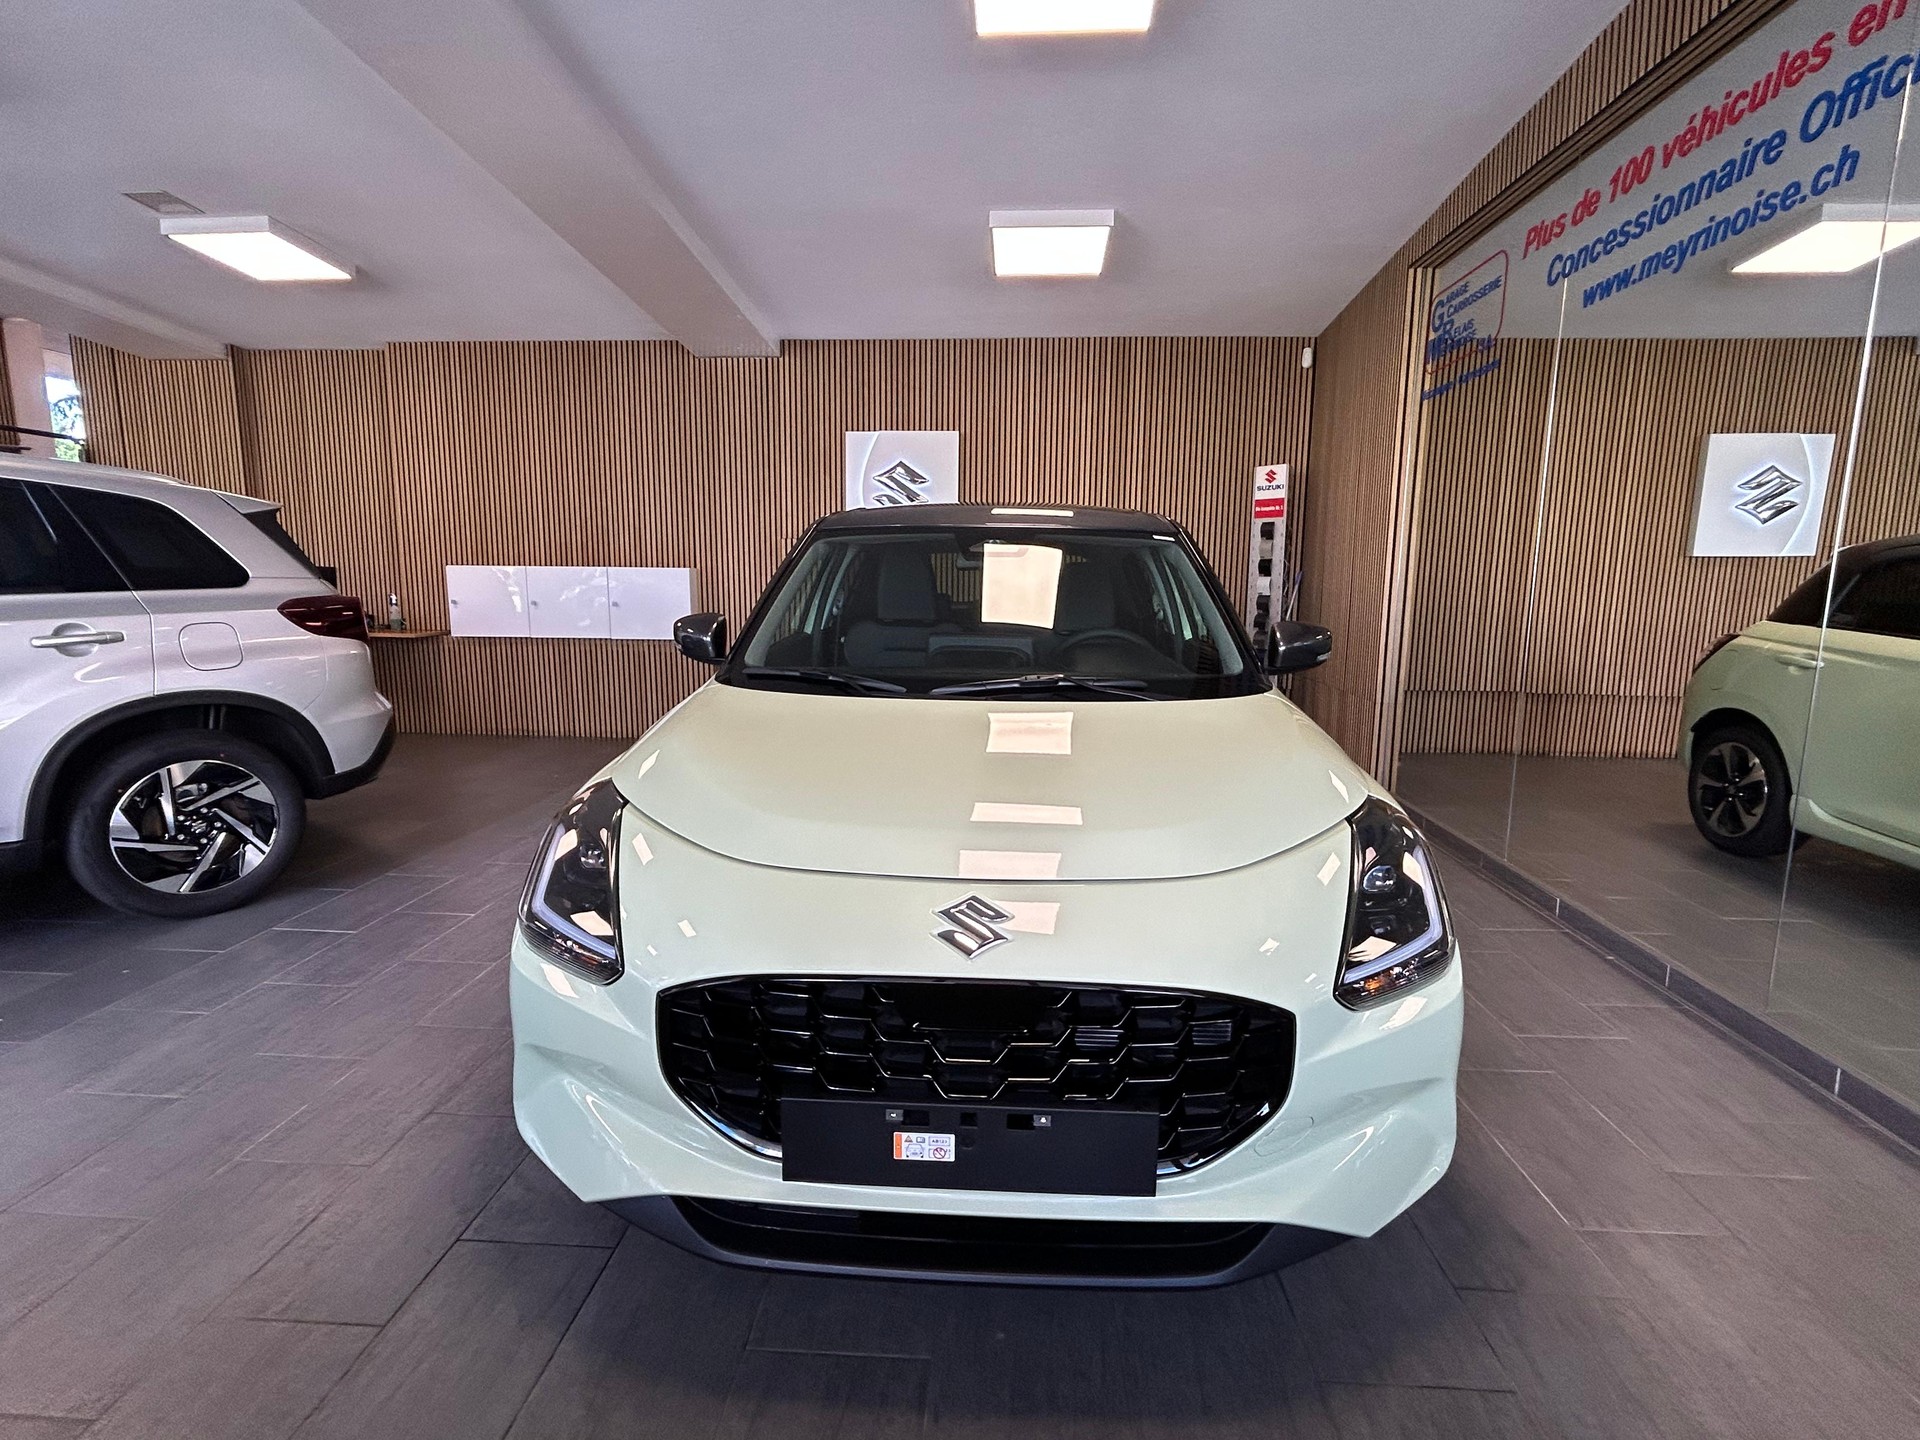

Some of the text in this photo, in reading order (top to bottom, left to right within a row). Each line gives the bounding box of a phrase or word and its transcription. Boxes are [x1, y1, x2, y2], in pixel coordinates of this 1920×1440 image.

[1522, 212, 1567, 260] Plus
[1571, 188, 1601, 226] de
[1609, 145, 1655, 203] 100
[1662, 31, 1835, 169] véhicules
[1547, 129, 1788, 287] Concessionnaire
[1583, 144, 1861, 308] www.meyrinoise.ch
